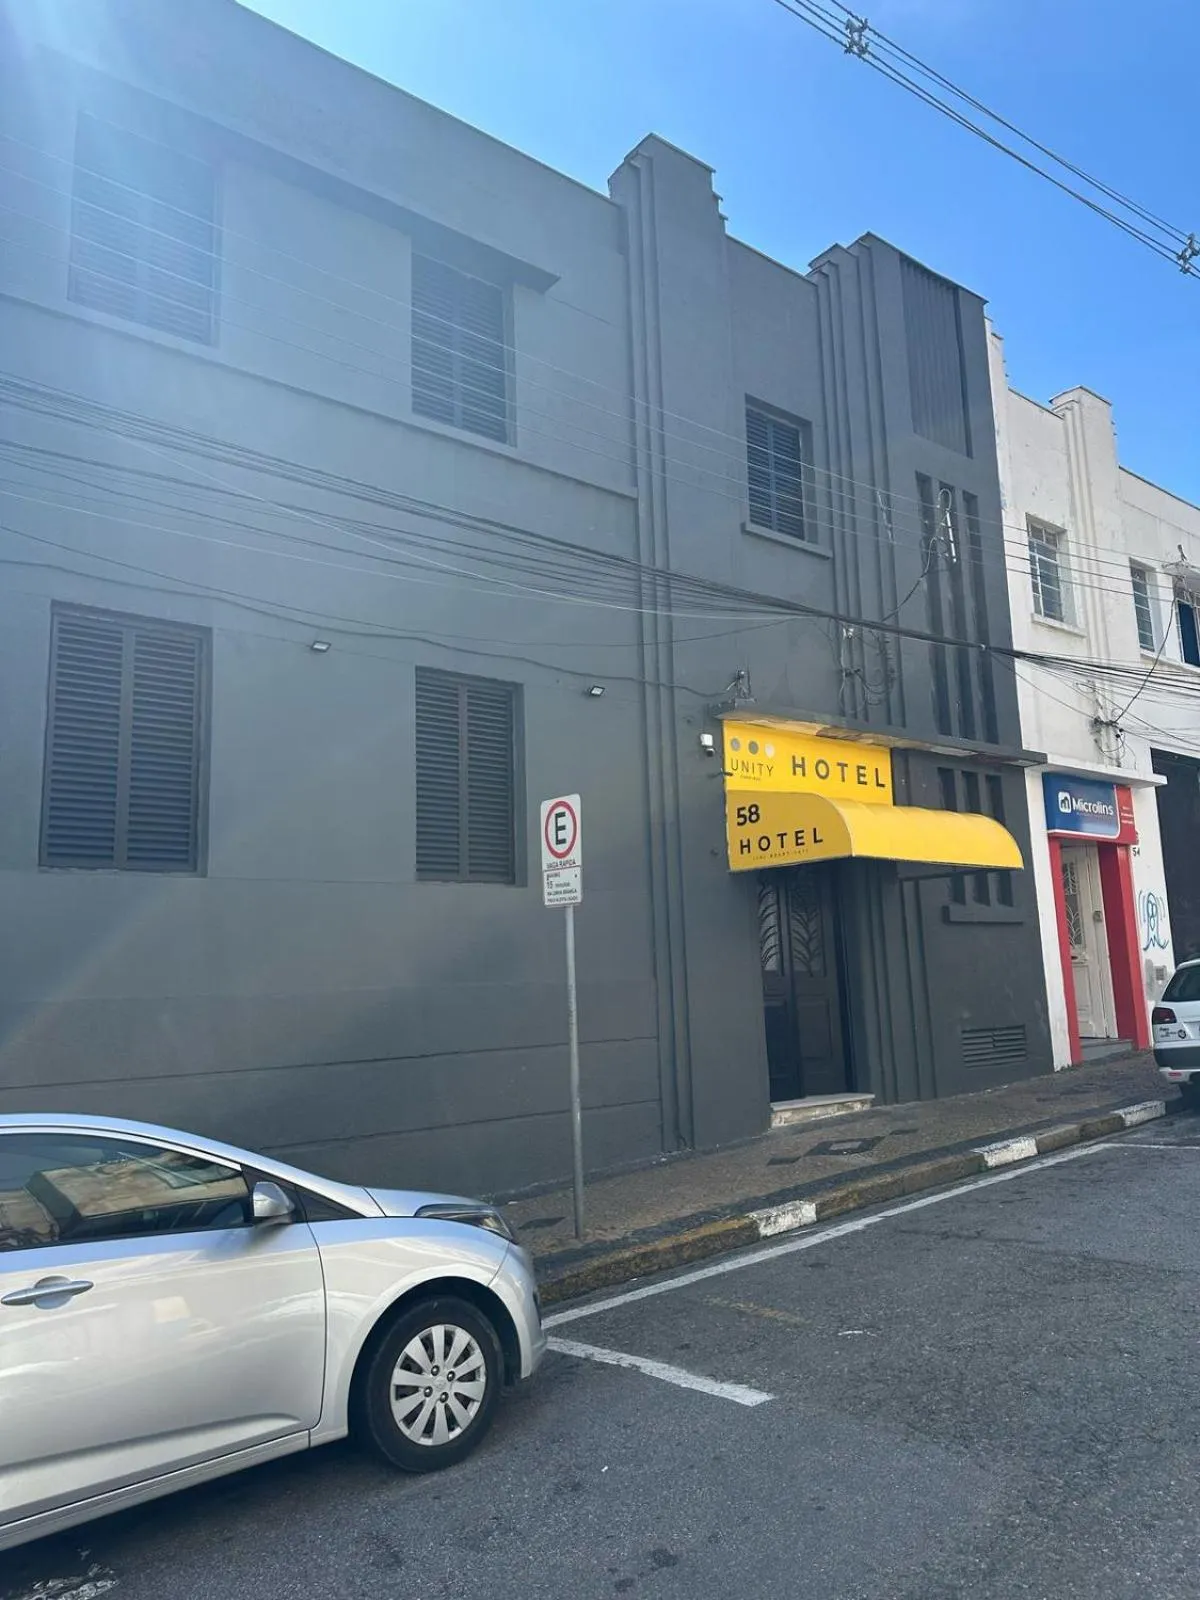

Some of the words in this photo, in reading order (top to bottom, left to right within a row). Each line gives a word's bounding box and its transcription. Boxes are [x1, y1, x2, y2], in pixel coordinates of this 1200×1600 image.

[730, 758, 774, 777] UNITY
[791, 755, 885, 788] HOTEL
[736, 804, 760, 826] 58
[1072, 797, 1114, 816] Microlins
[554, 811, 567, 845] E
[739, 827, 823, 855] HOTEL
[1132, 847, 1141, 857] 54
